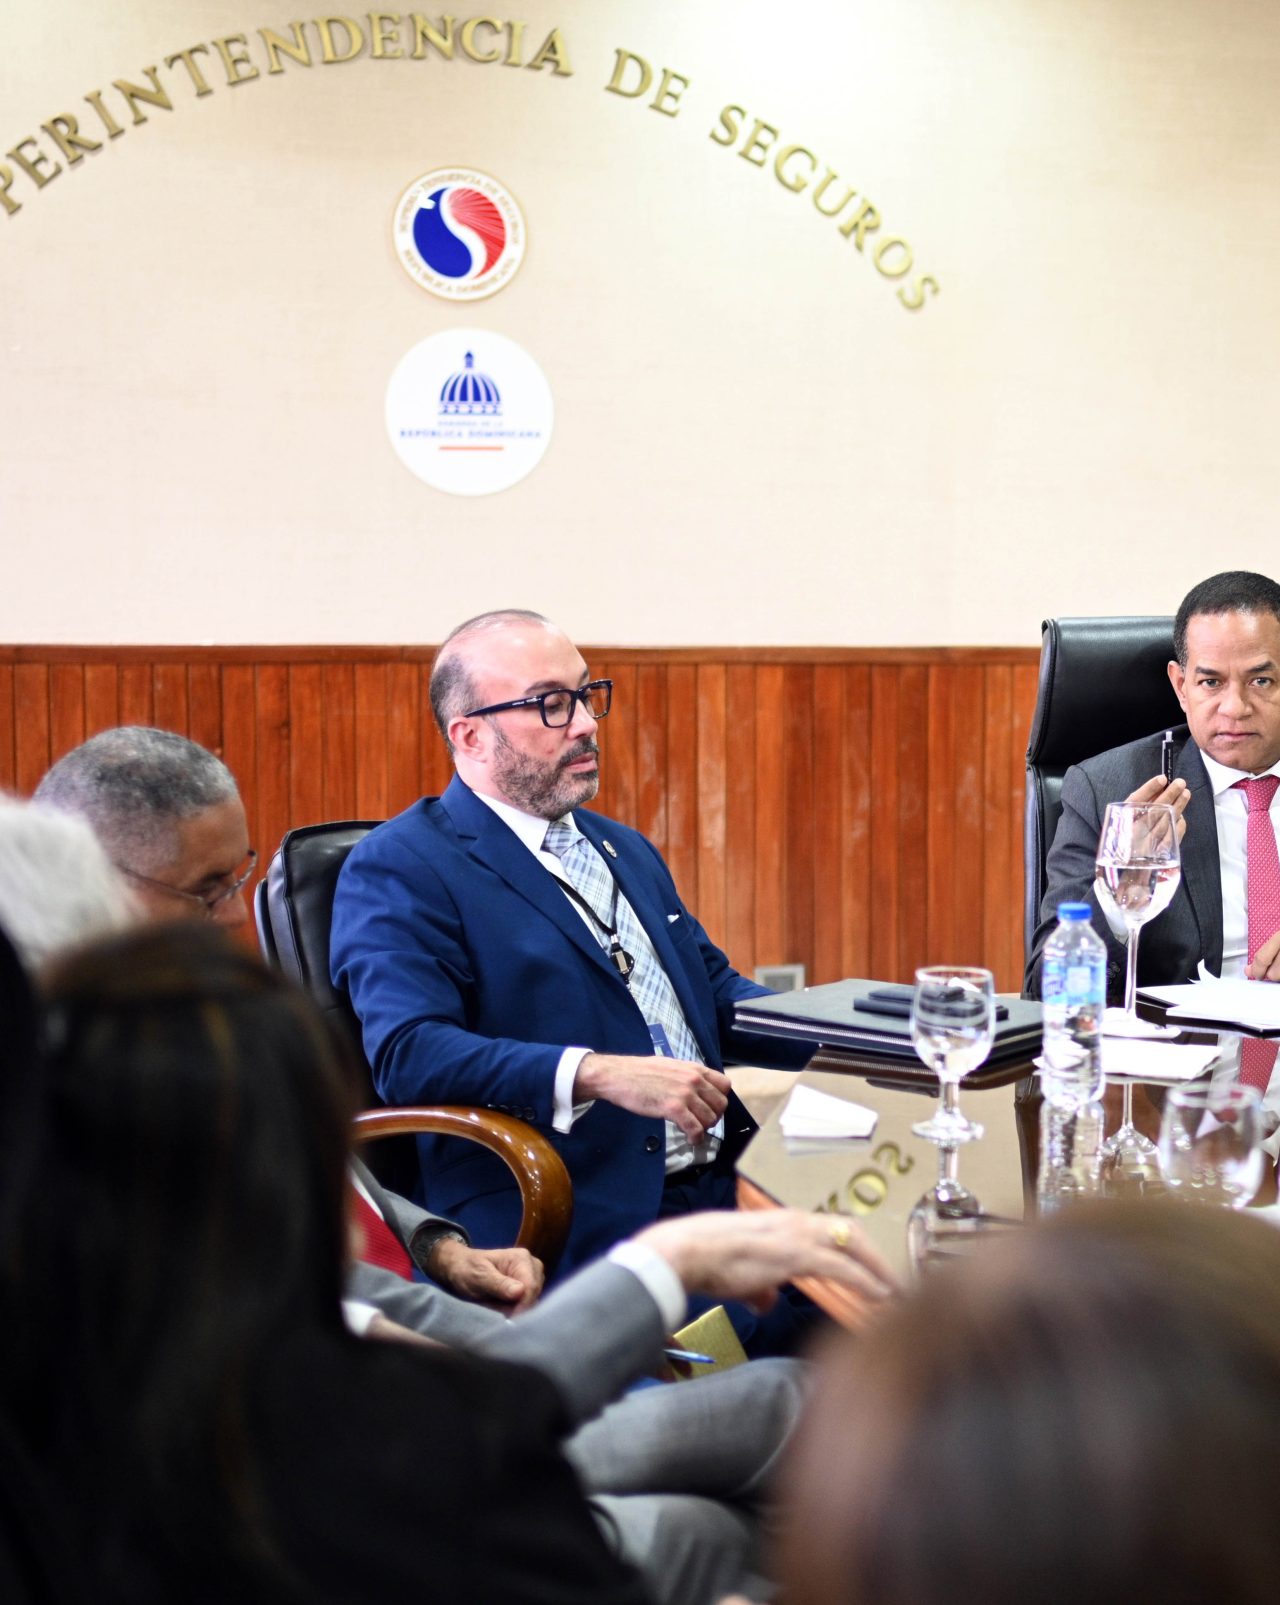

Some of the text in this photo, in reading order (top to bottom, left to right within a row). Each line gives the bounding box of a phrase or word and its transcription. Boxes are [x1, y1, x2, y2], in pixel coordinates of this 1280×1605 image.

[0, 12, 940, 312] PERINTENDENCIA DE SEGUROS
